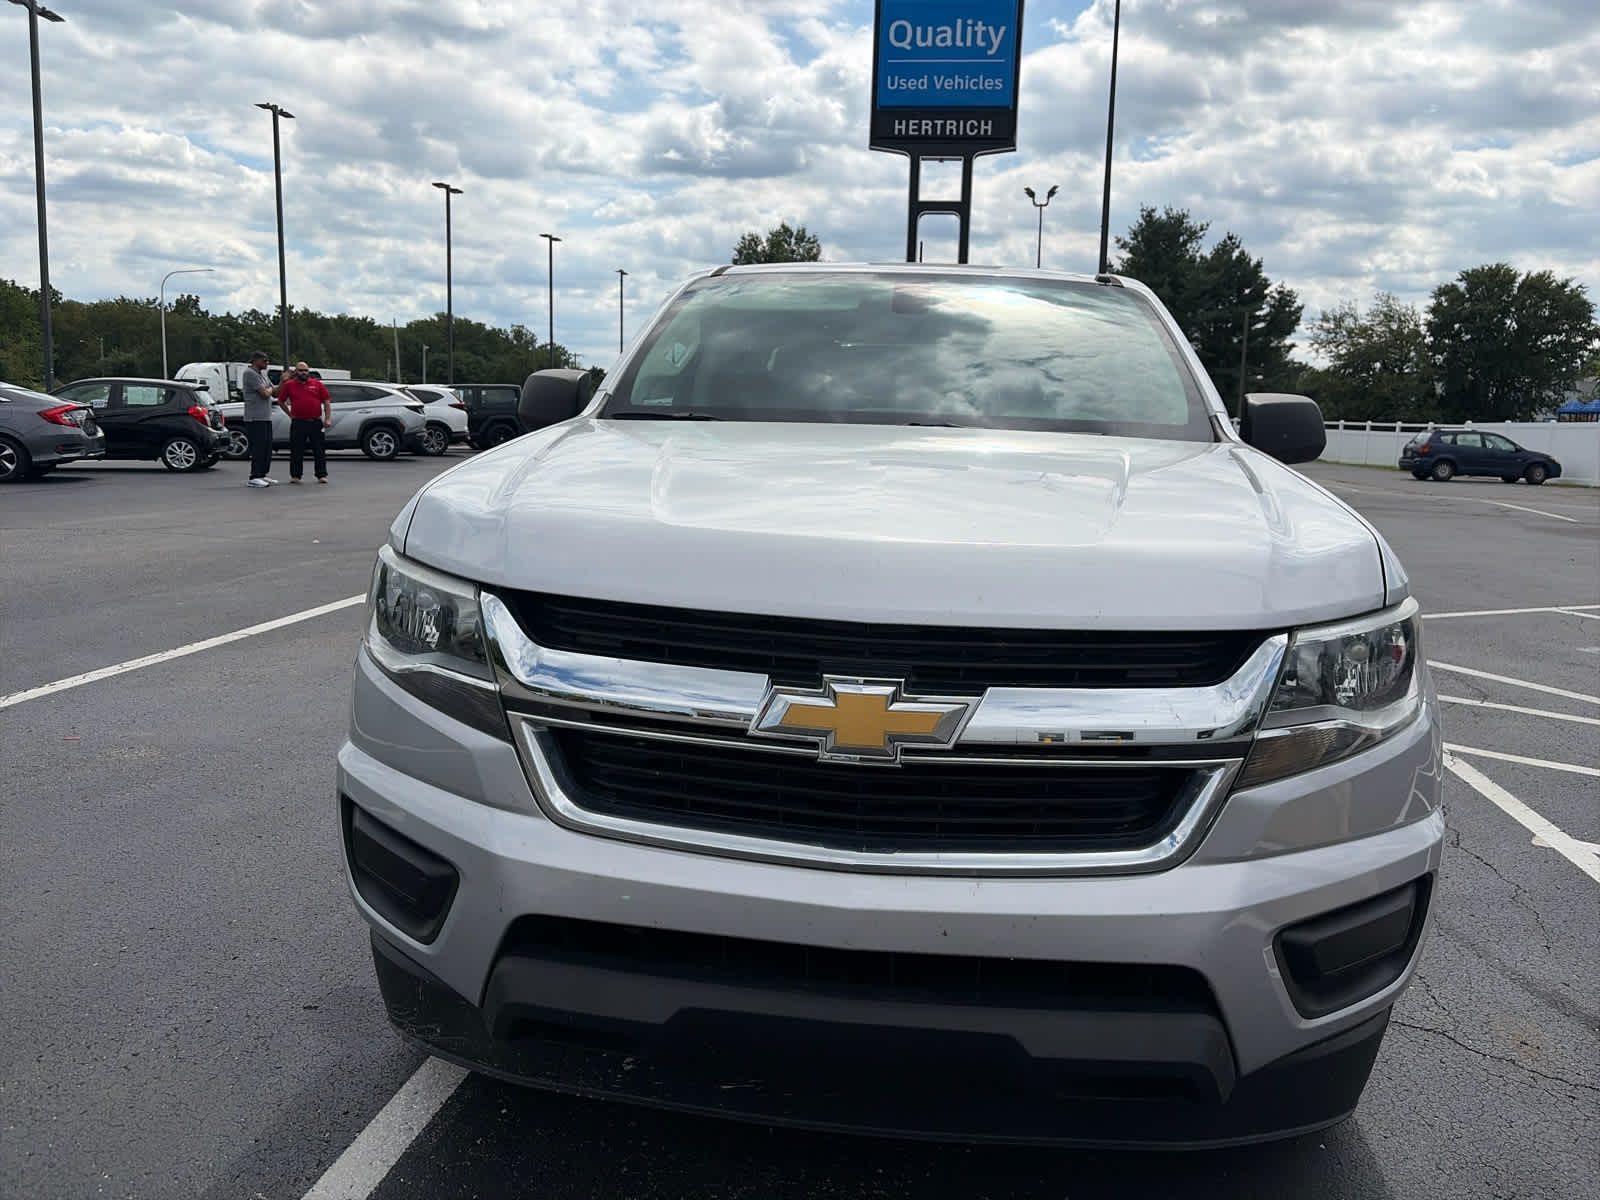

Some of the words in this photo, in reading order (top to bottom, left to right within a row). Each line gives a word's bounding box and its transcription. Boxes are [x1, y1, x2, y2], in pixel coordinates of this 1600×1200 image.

[888, 18, 1007, 56] Quality
[887, 75, 928, 90] Used
[933, 75, 1003, 90] Vehicles
[894, 119, 993, 136] HERTRICH
